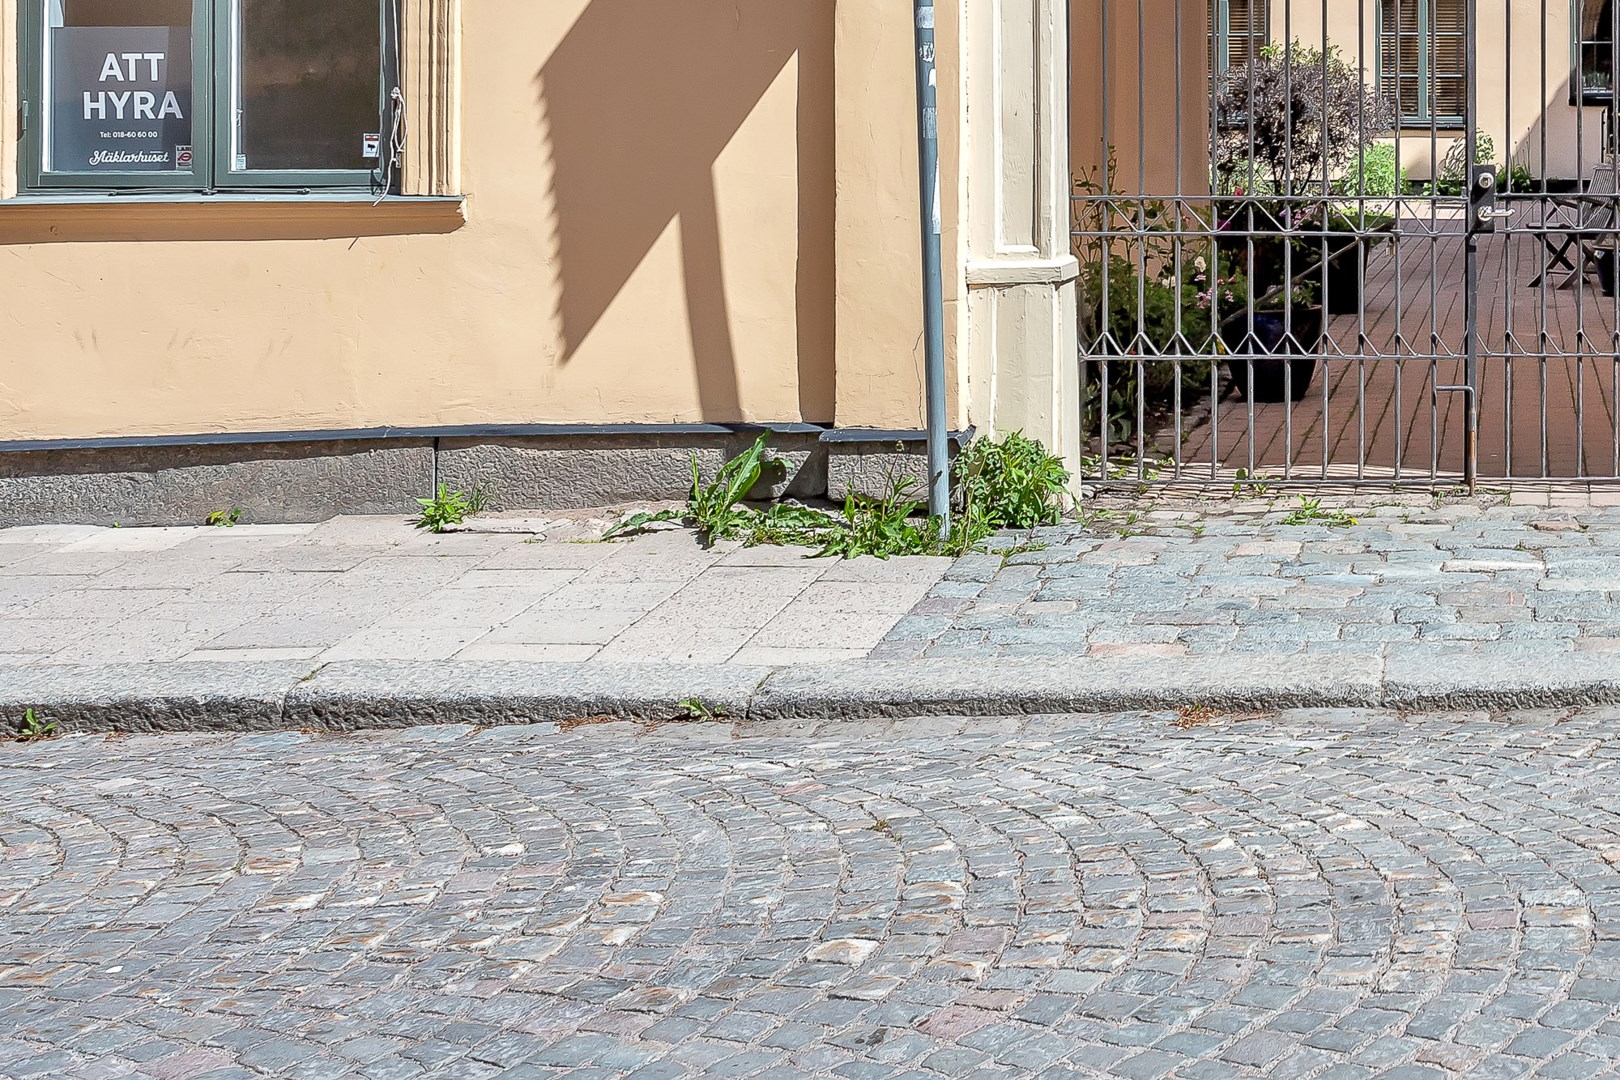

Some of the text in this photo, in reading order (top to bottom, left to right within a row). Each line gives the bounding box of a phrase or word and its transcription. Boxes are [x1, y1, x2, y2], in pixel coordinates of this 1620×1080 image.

[98, 52, 165, 82] ATT
[82, 90, 184, 120] HYRA
[89, 150, 170, 166] Mäklarhuset
